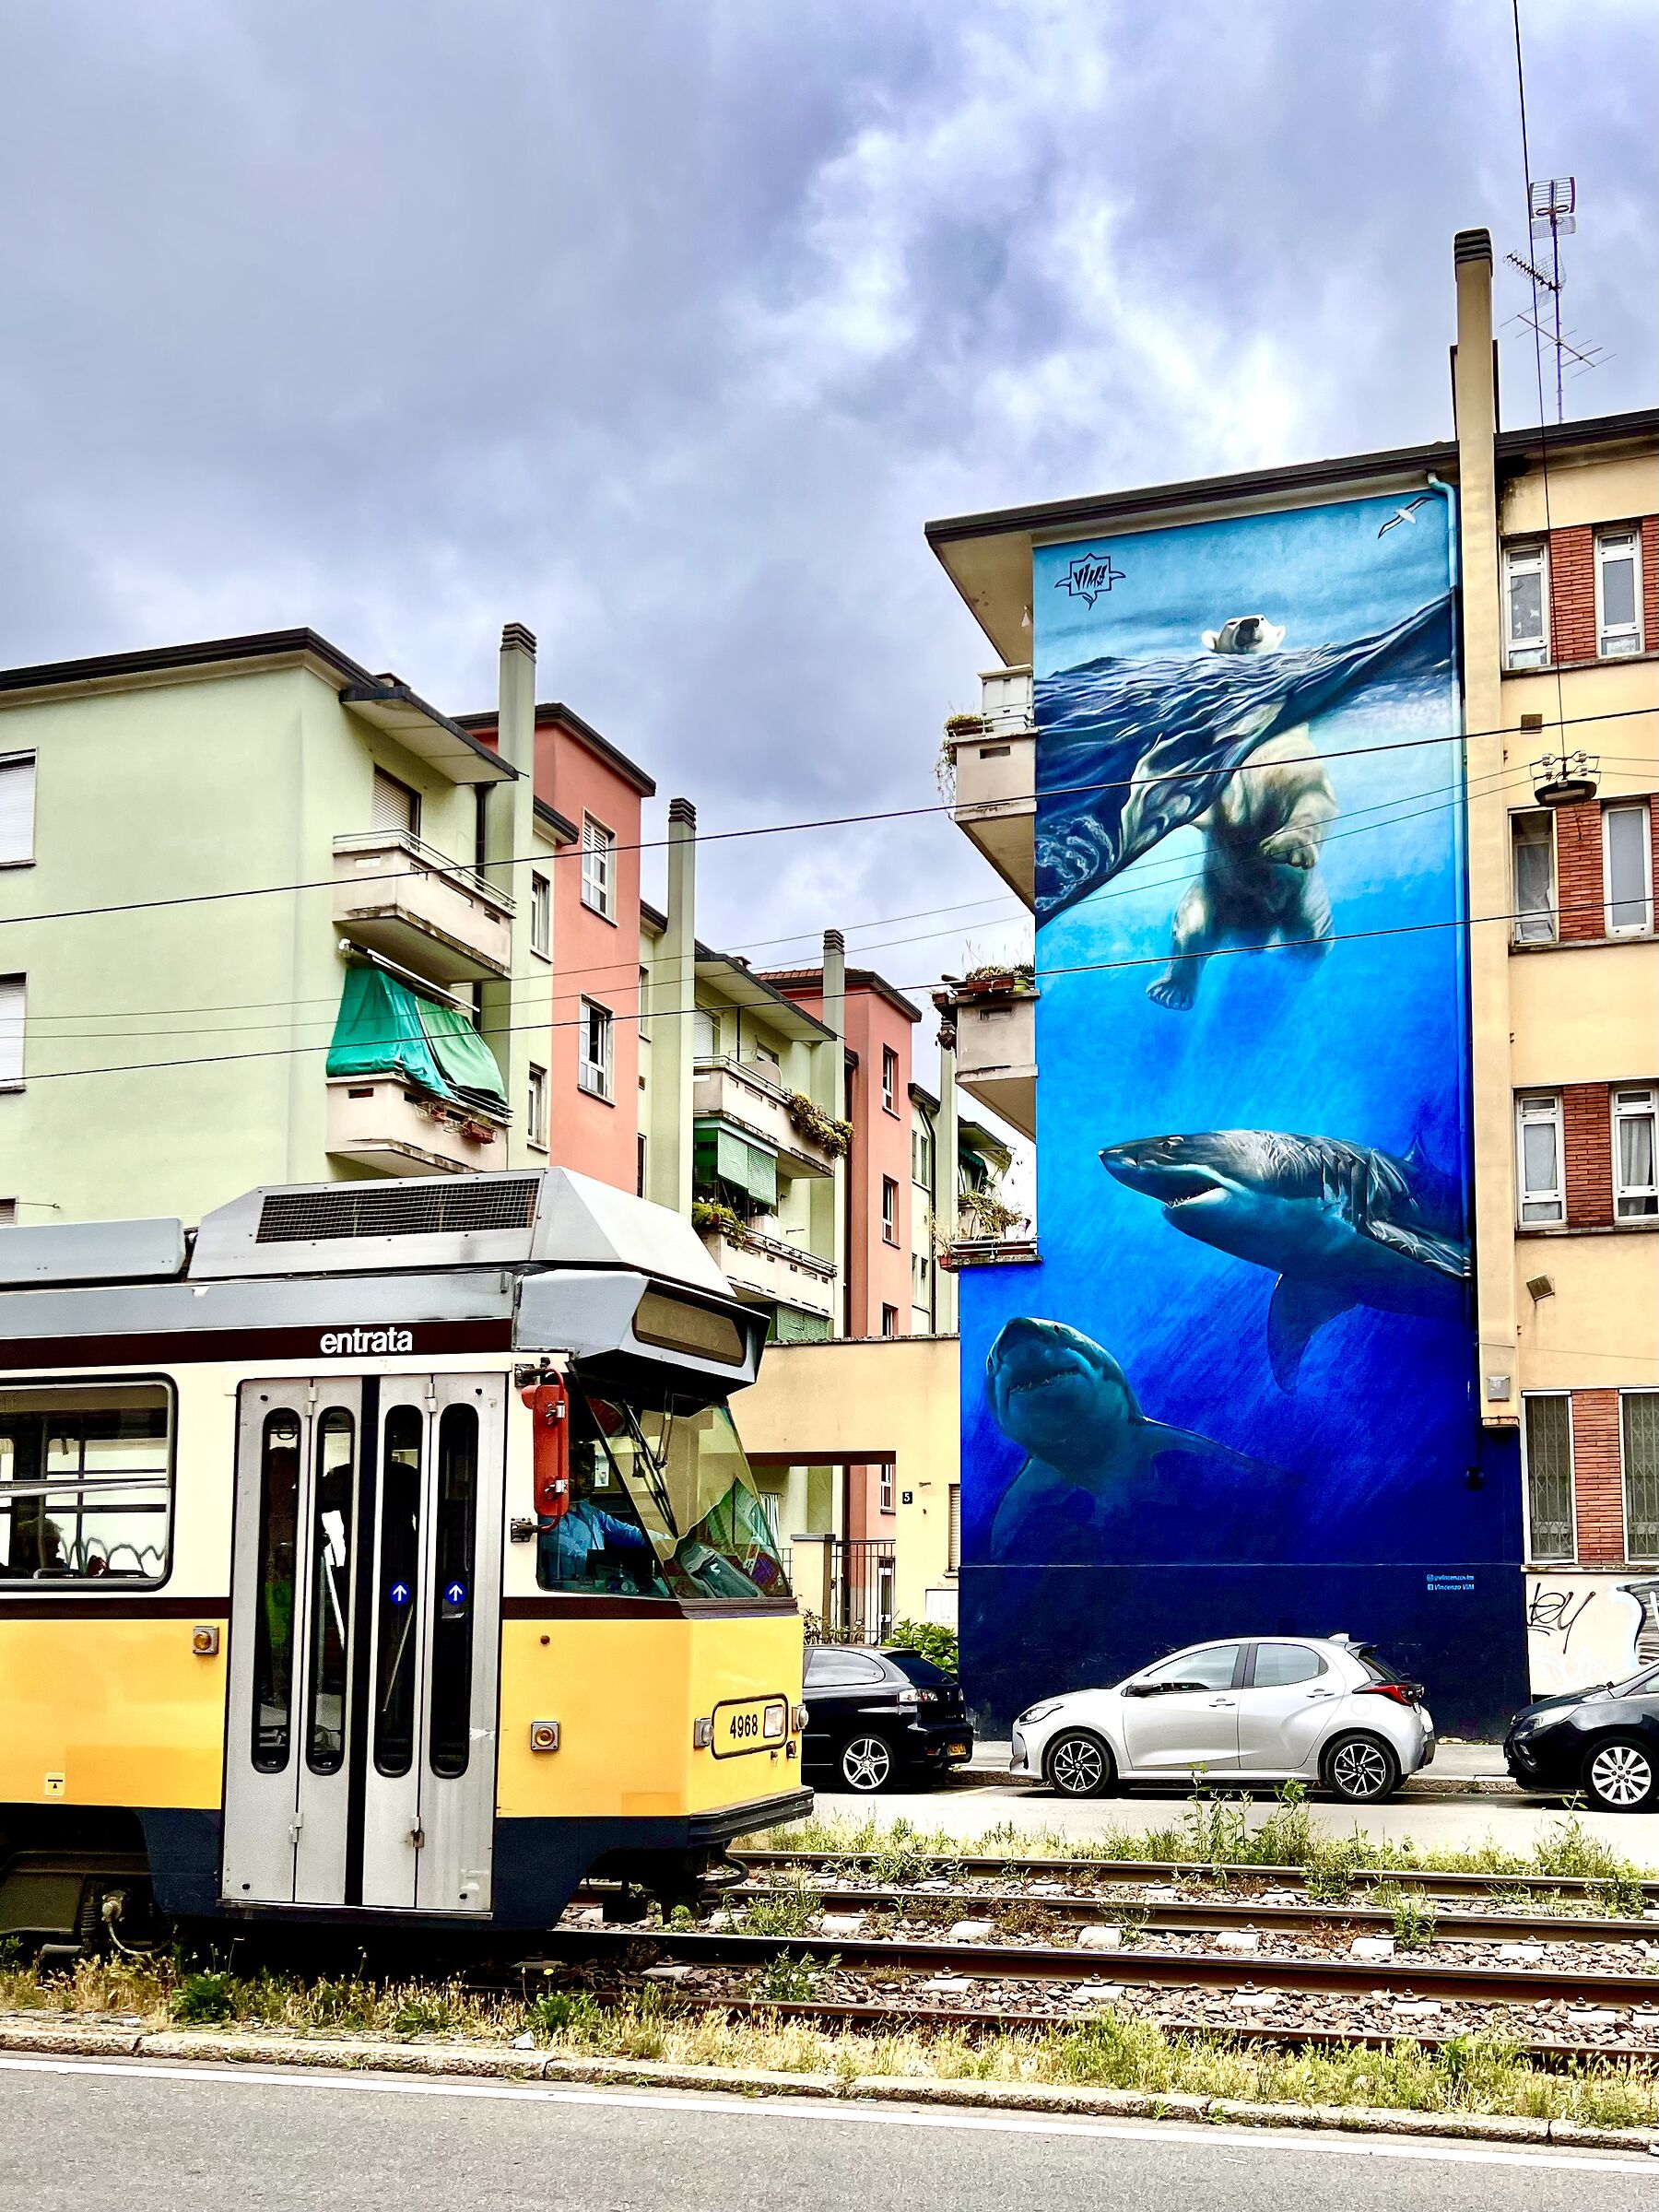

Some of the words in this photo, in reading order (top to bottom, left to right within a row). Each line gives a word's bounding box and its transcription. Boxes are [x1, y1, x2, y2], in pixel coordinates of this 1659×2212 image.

[319, 1326, 414, 1355] entrata
[903, 1492, 911, 1502] 5
[730, 1713, 758, 1739] 4968
